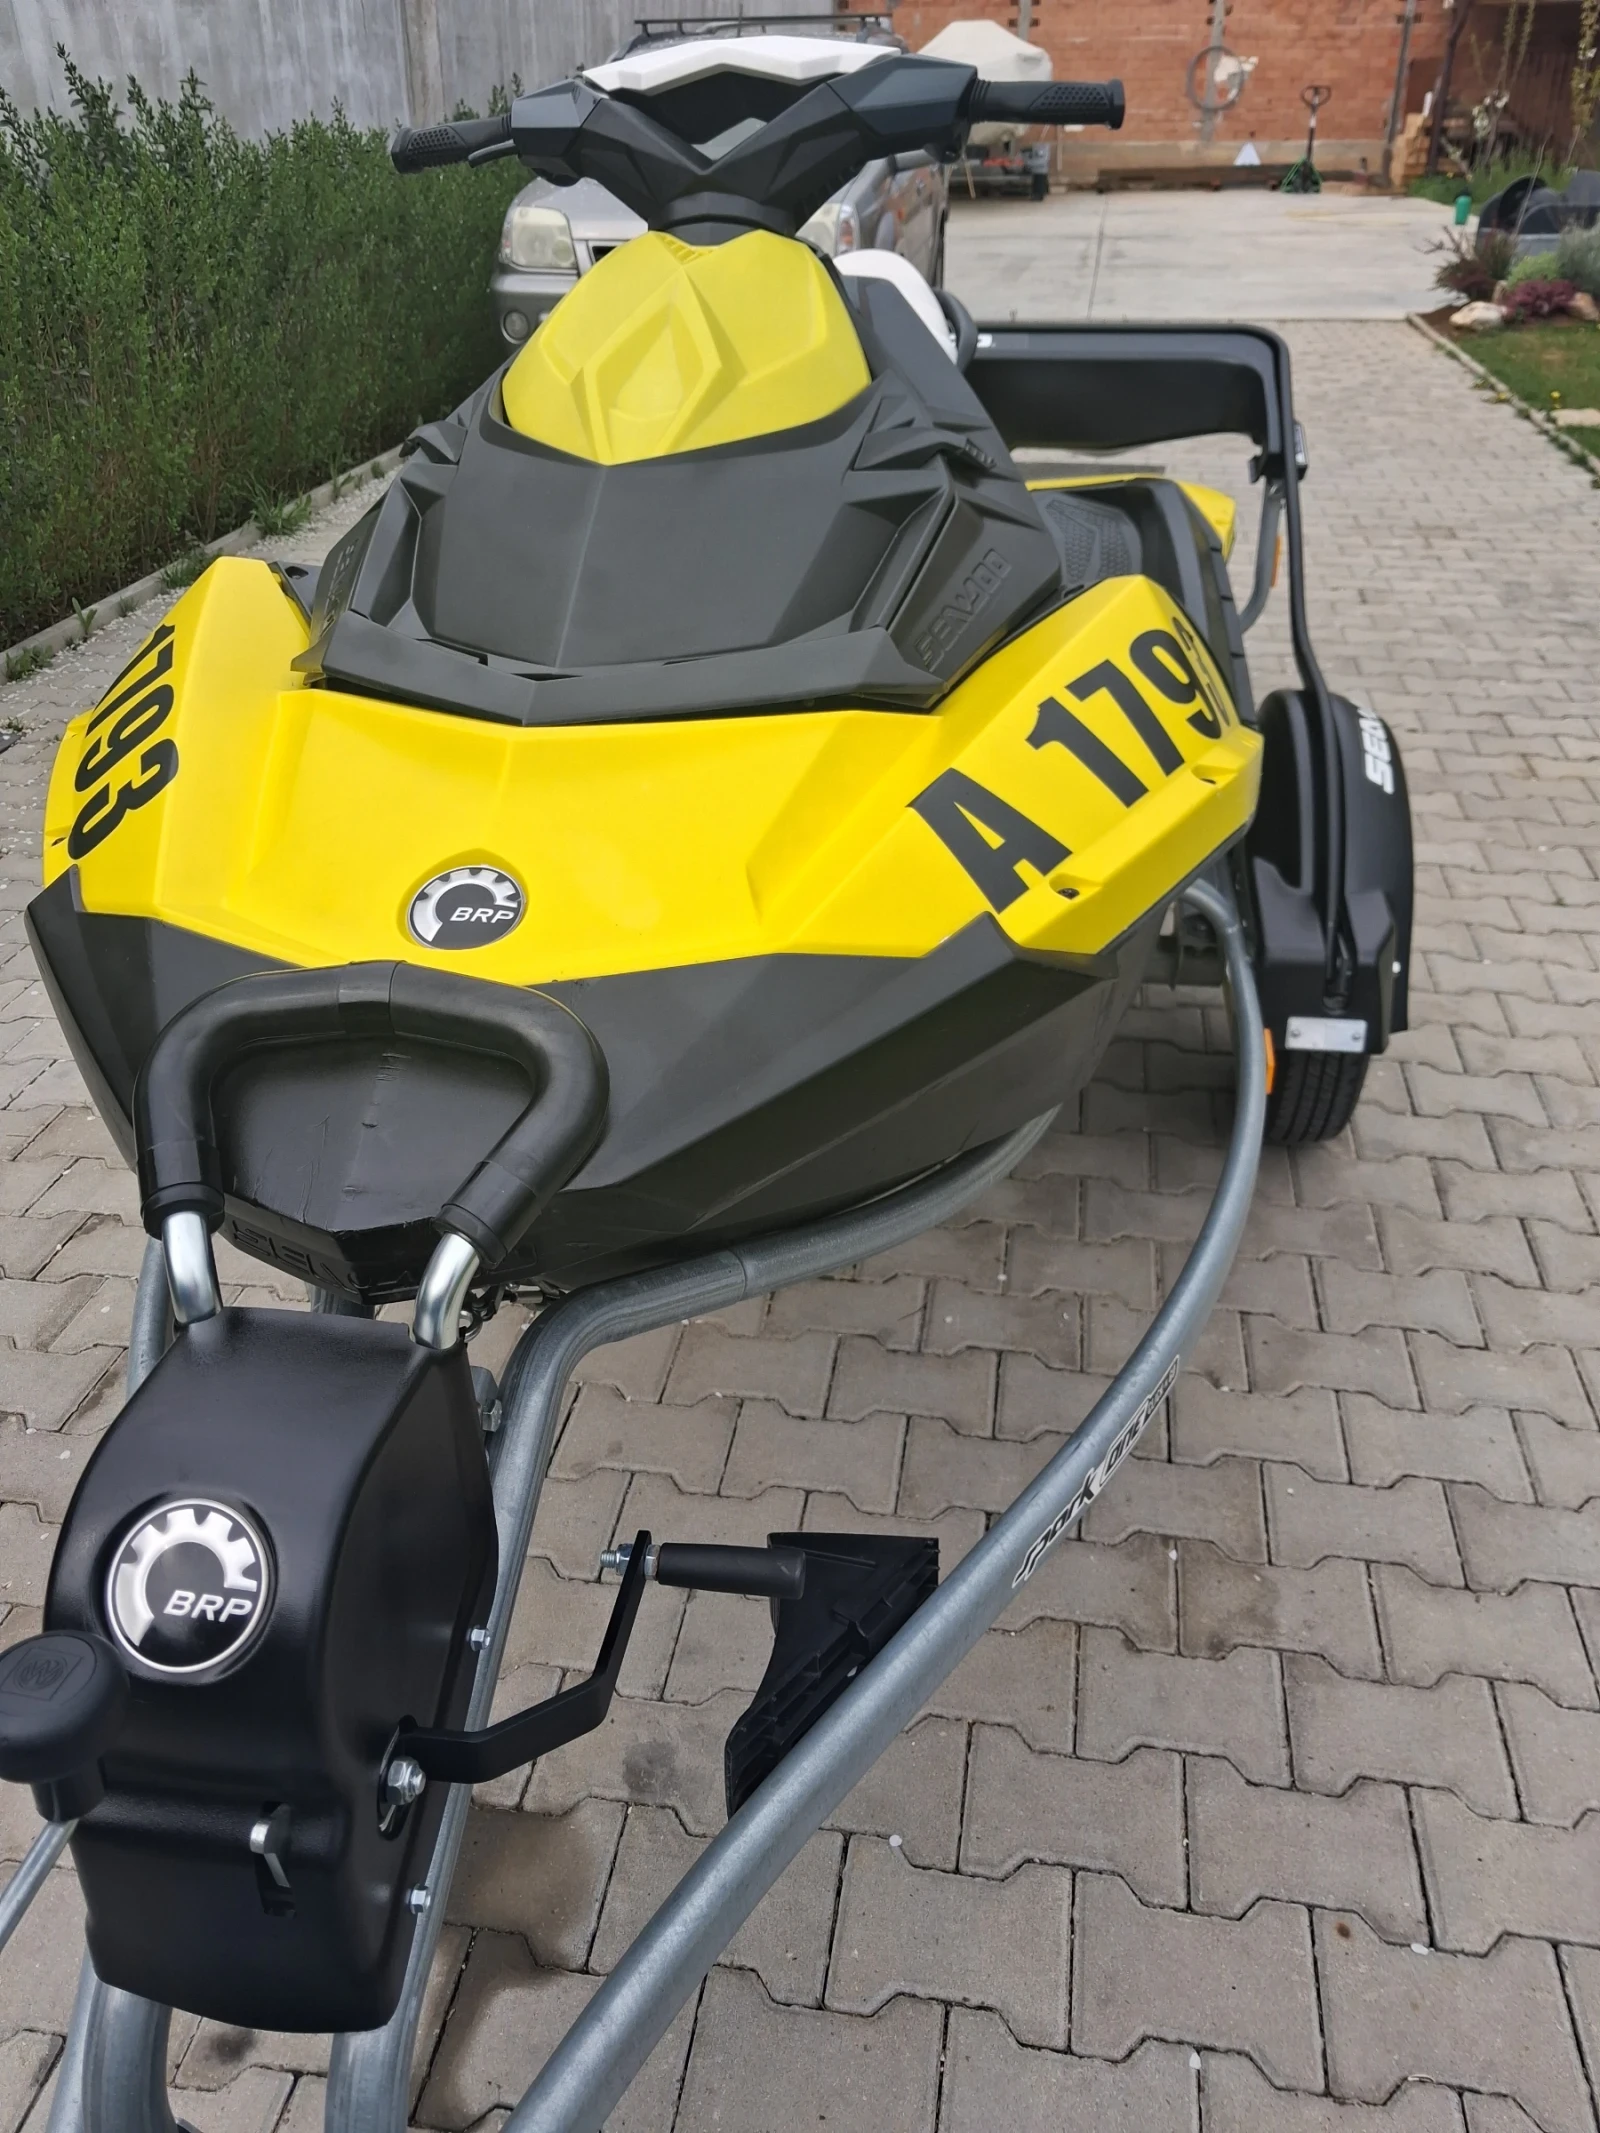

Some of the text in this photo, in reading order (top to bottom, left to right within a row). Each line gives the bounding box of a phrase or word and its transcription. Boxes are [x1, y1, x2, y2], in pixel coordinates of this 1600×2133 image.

[68, 624, 179, 860] 1793
[905, 767, 1072, 915] A
[450, 907, 515, 923] BRP
[163, 1589, 252, 1623] BRP
